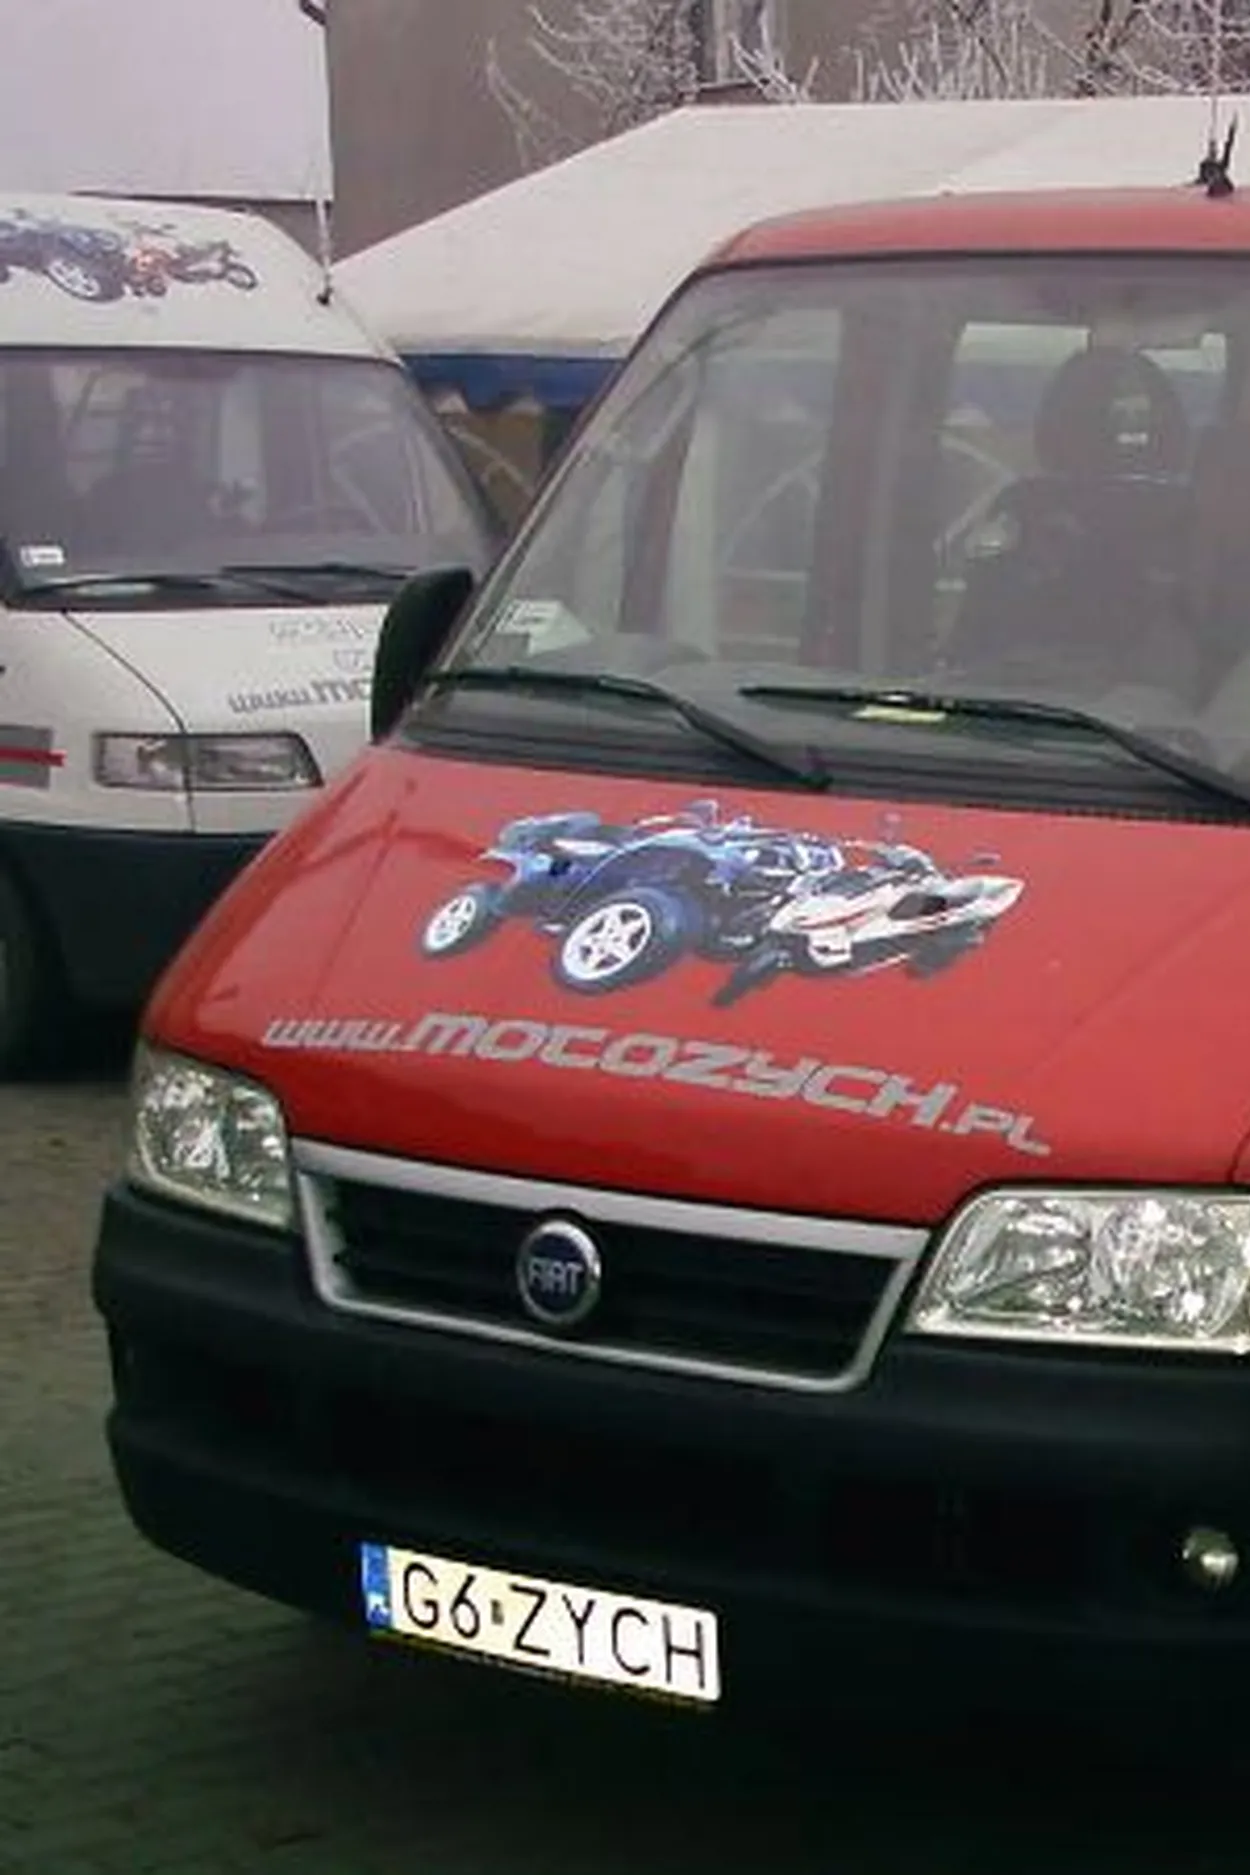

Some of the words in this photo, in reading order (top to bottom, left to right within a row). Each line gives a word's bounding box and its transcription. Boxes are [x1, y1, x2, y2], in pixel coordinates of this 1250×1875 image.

[528, 1256, 585, 1295] FIAT
[403, 1561, 480, 1639] G6
[510, 1583, 706, 1690] ZYCH
